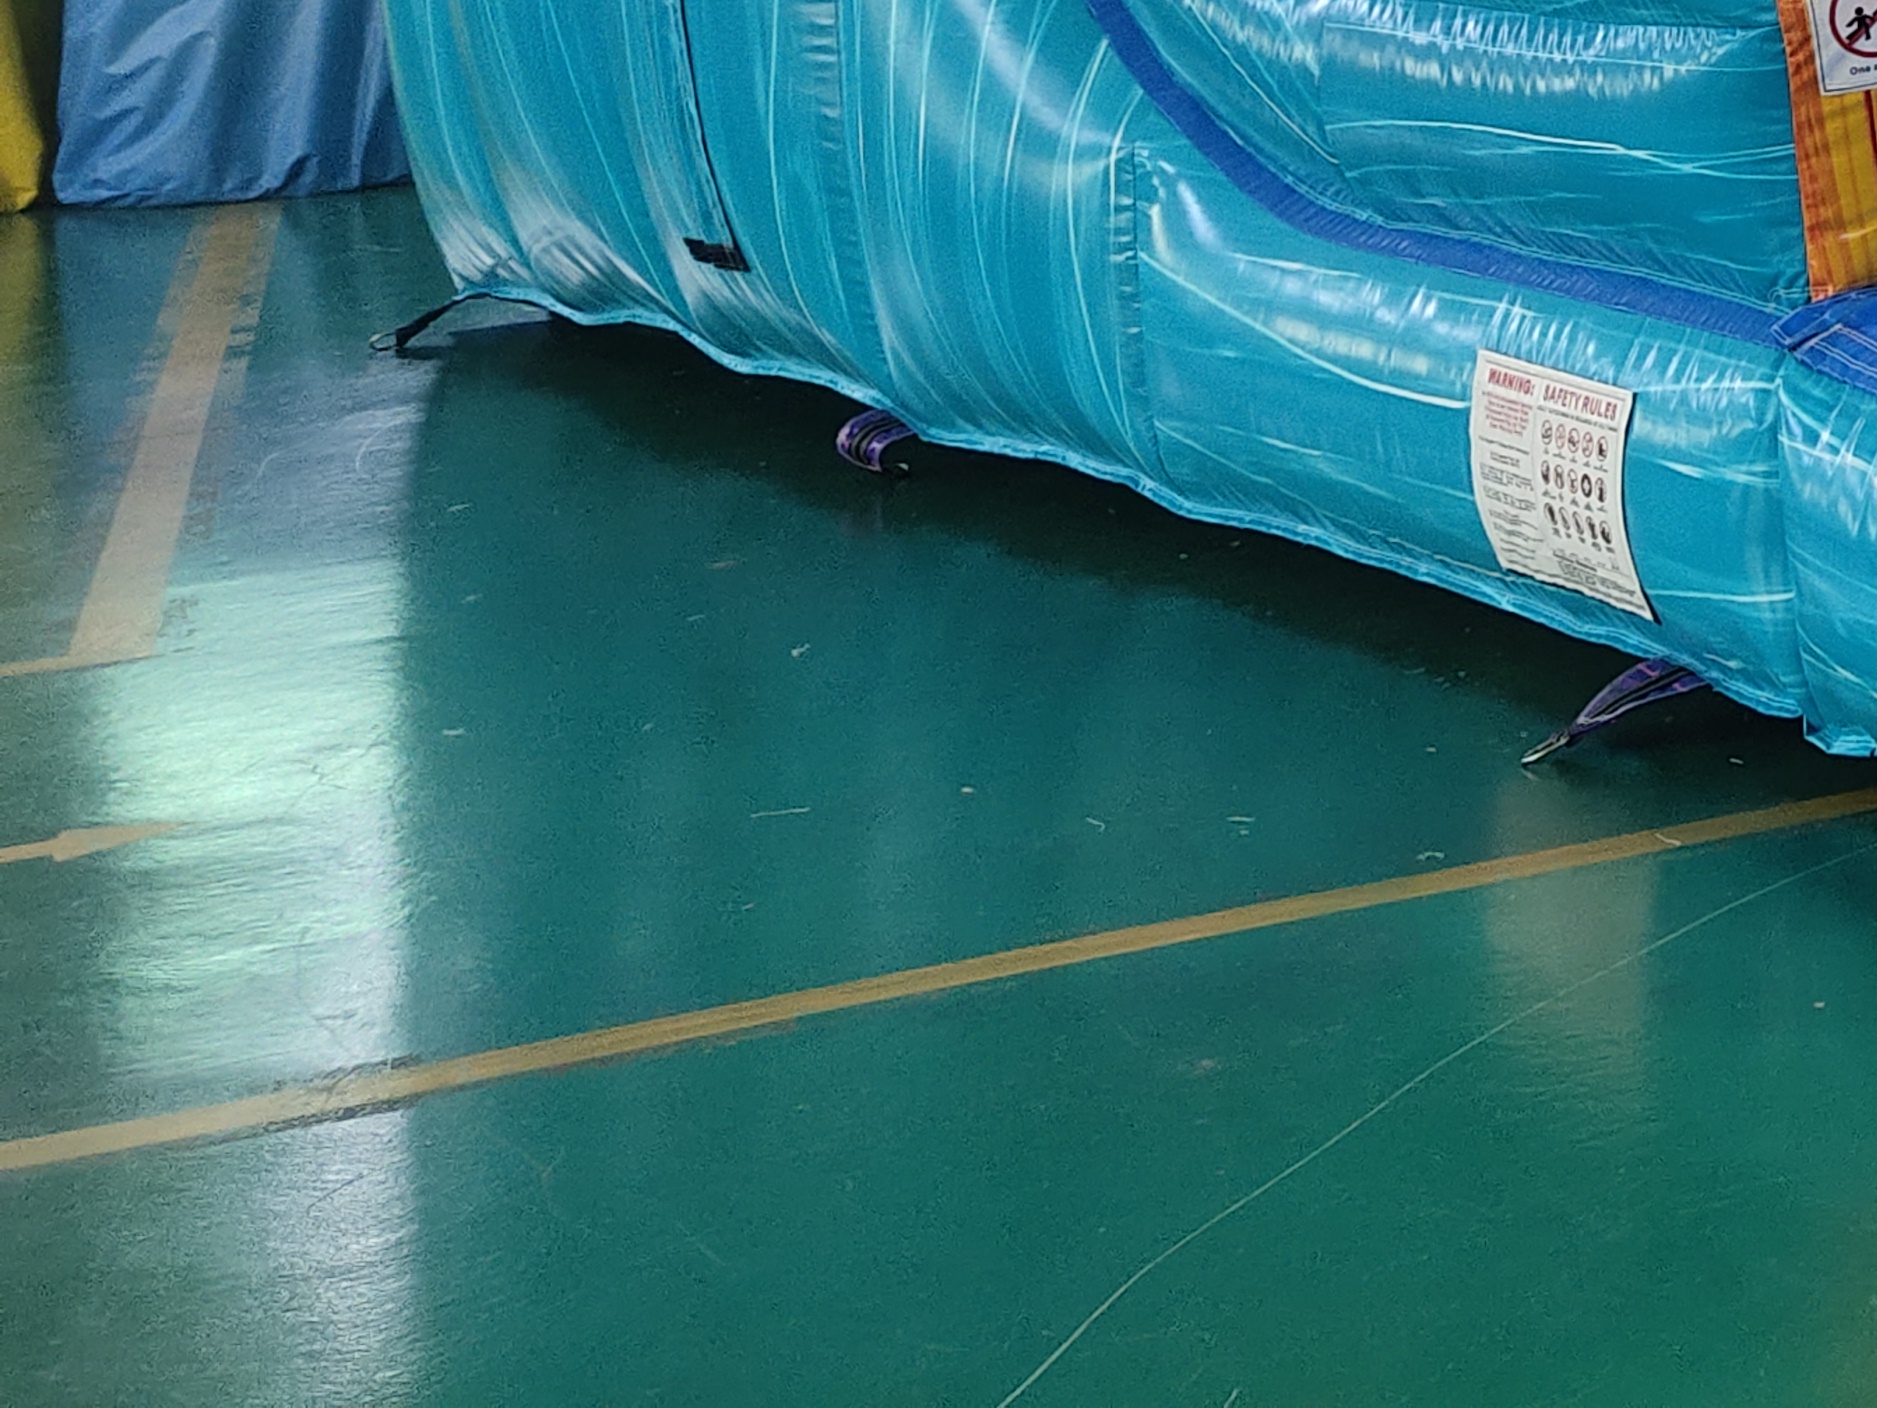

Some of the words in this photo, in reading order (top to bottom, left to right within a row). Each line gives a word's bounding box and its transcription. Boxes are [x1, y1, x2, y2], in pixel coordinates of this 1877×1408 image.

[1849, 66, 1871, 75] One
[1487, 367, 1536, 397] WARNING:
[1543, 384, 1582, 412] SAFETY
[1582, 394, 1619, 422] RULES
